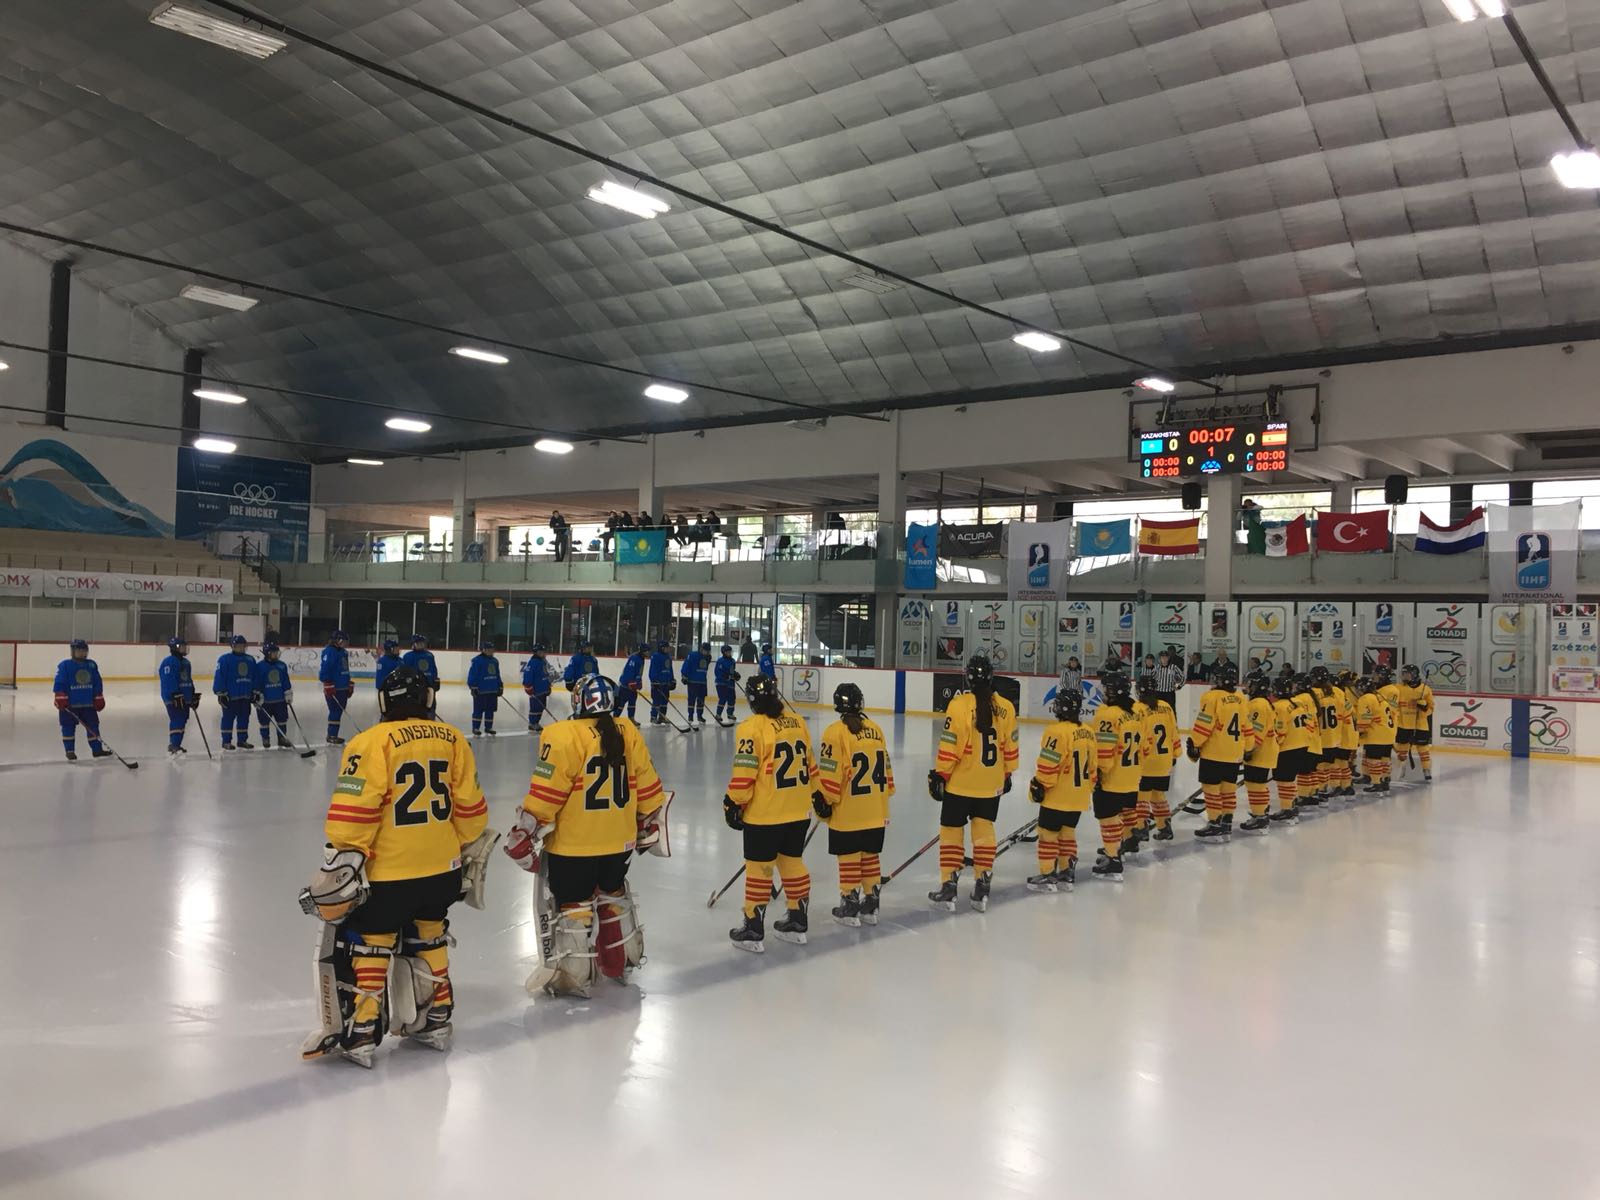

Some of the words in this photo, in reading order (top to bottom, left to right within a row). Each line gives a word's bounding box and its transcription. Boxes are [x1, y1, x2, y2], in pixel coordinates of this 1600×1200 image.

[1189, 428, 1235, 444] 00:07
[1245, 433, 1255, 446] 0
[1169, 438, 1178, 451] 0
[1207, 446, 1214, 457] 1
[1227, 453, 1235, 462] 0
[1256, 450, 1285, 461] 00:00
[1144, 458, 1151, 468] 0
[1153, 456, 1180, 467] 00:00
[1187, 455, 1194, 465] 0
[1256, 461, 1285, 471] 00:00
[1144, 468, 1151, 478] 0
[1152, 466, 1180, 477] 00:00
[229, 504, 244, 516] ICE
[245, 506, 278, 519] HOCKEY
[957, 531, 994, 541] ACURA
[908, 557, 933, 566] lumen
[0, 574, 31, 586] DMX
[56, 576, 100, 589] CDMX
[123, 579, 164, 592] CDMX
[1521, 575, 1547, 584] IIHF
[185, 582, 224, 594] CDMX
[1160, 623, 1190, 632] CONAD
[1428, 629, 1466, 638] CONADE
[1057, 642, 1079, 653] zoé
[1552, 642, 1573, 651] zoé
[1575, 643, 1596, 652] zoé
[944, 716, 952, 730] 6
[1322, 705, 1339, 730] 16
[1099, 720, 1113, 733] 22
[1226, 712, 1241, 742] 4
[1441, 727, 1487, 738] CONADE
[1046, 736, 1058, 750] 14
[1153, 724, 1169, 755] 2
[738, 738, 754, 755] 23
[820, 742, 833, 759] 24
[981, 727, 998, 768] 6
[773, 740, 810, 790] 23
[850, 750, 888, 797] 24
[584, 753, 631, 811] 20
[394, 759, 453, 827] 25
